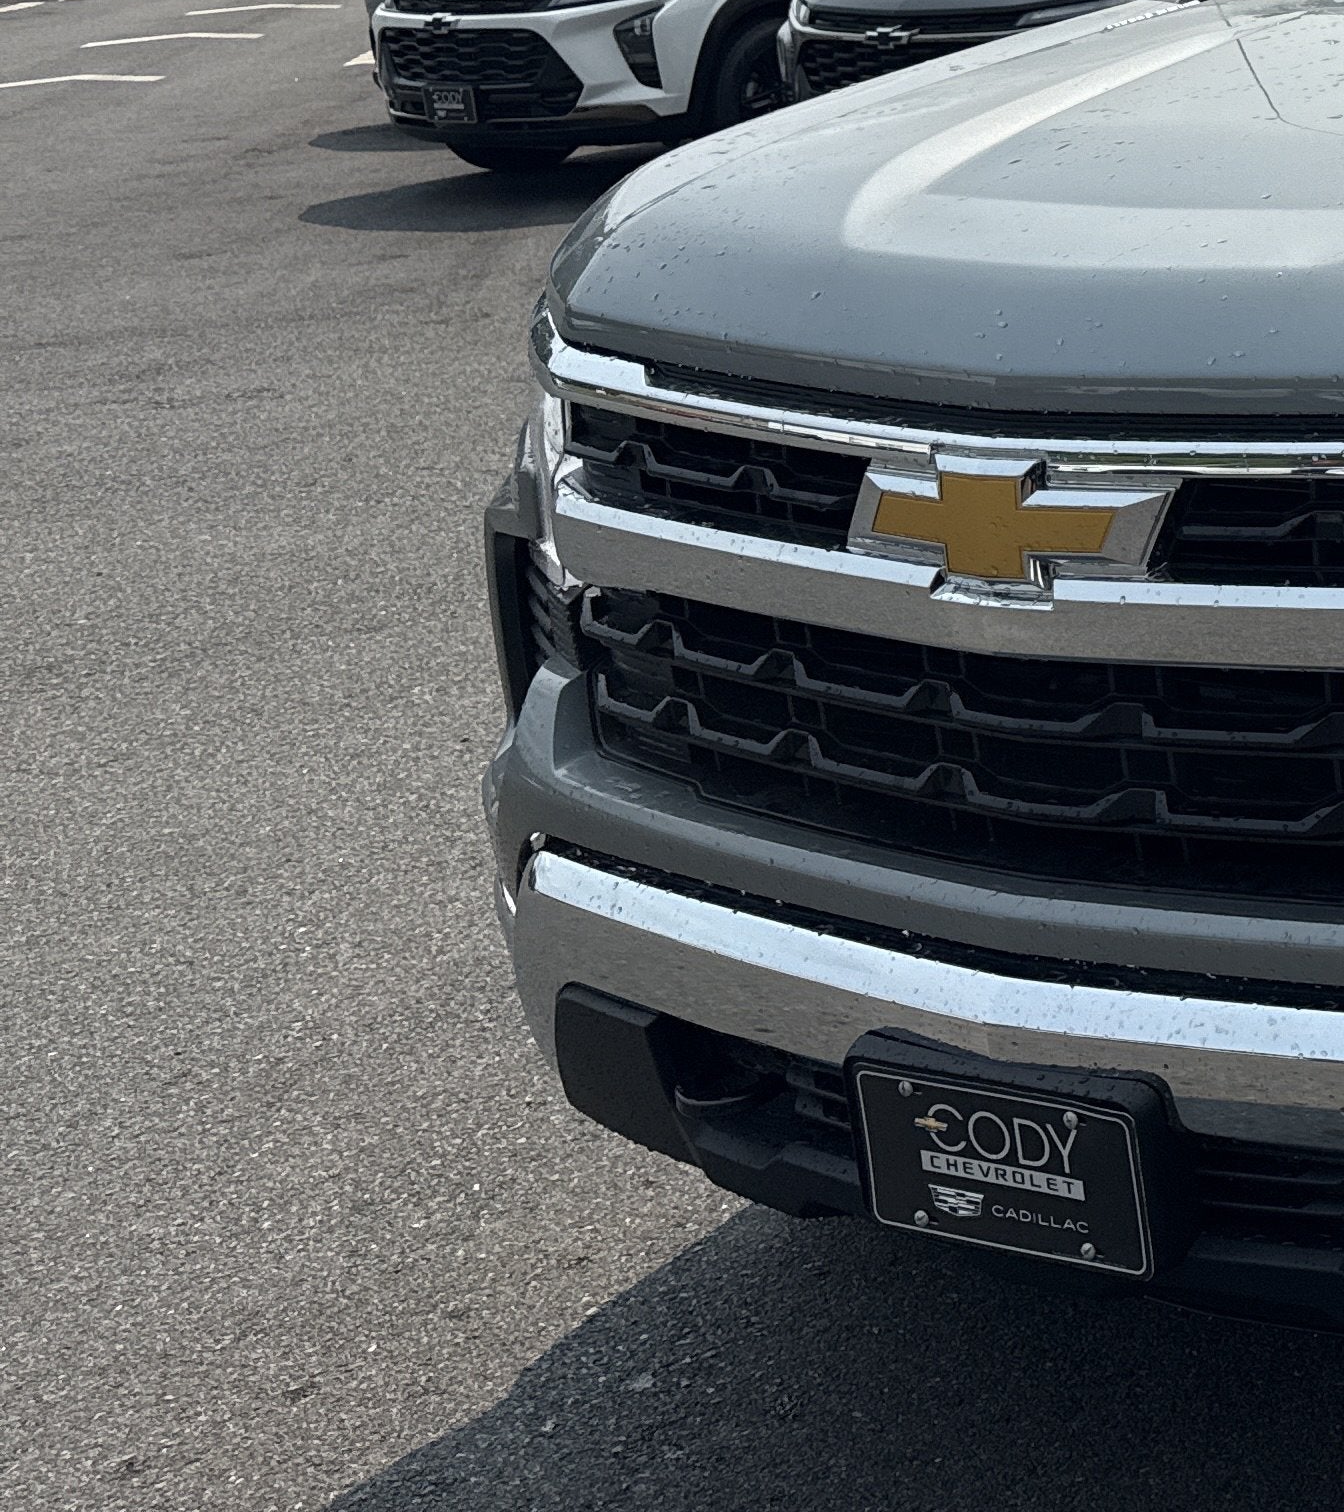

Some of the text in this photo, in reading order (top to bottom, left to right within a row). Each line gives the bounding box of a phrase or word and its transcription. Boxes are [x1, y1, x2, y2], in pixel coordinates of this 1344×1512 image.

[434, 90, 462, 104] CODY
[922, 1102, 1078, 1174] CODY
[929, 1154, 1075, 1195] CHEVROLET
[990, 1204, 1090, 1234] CADILLAC
